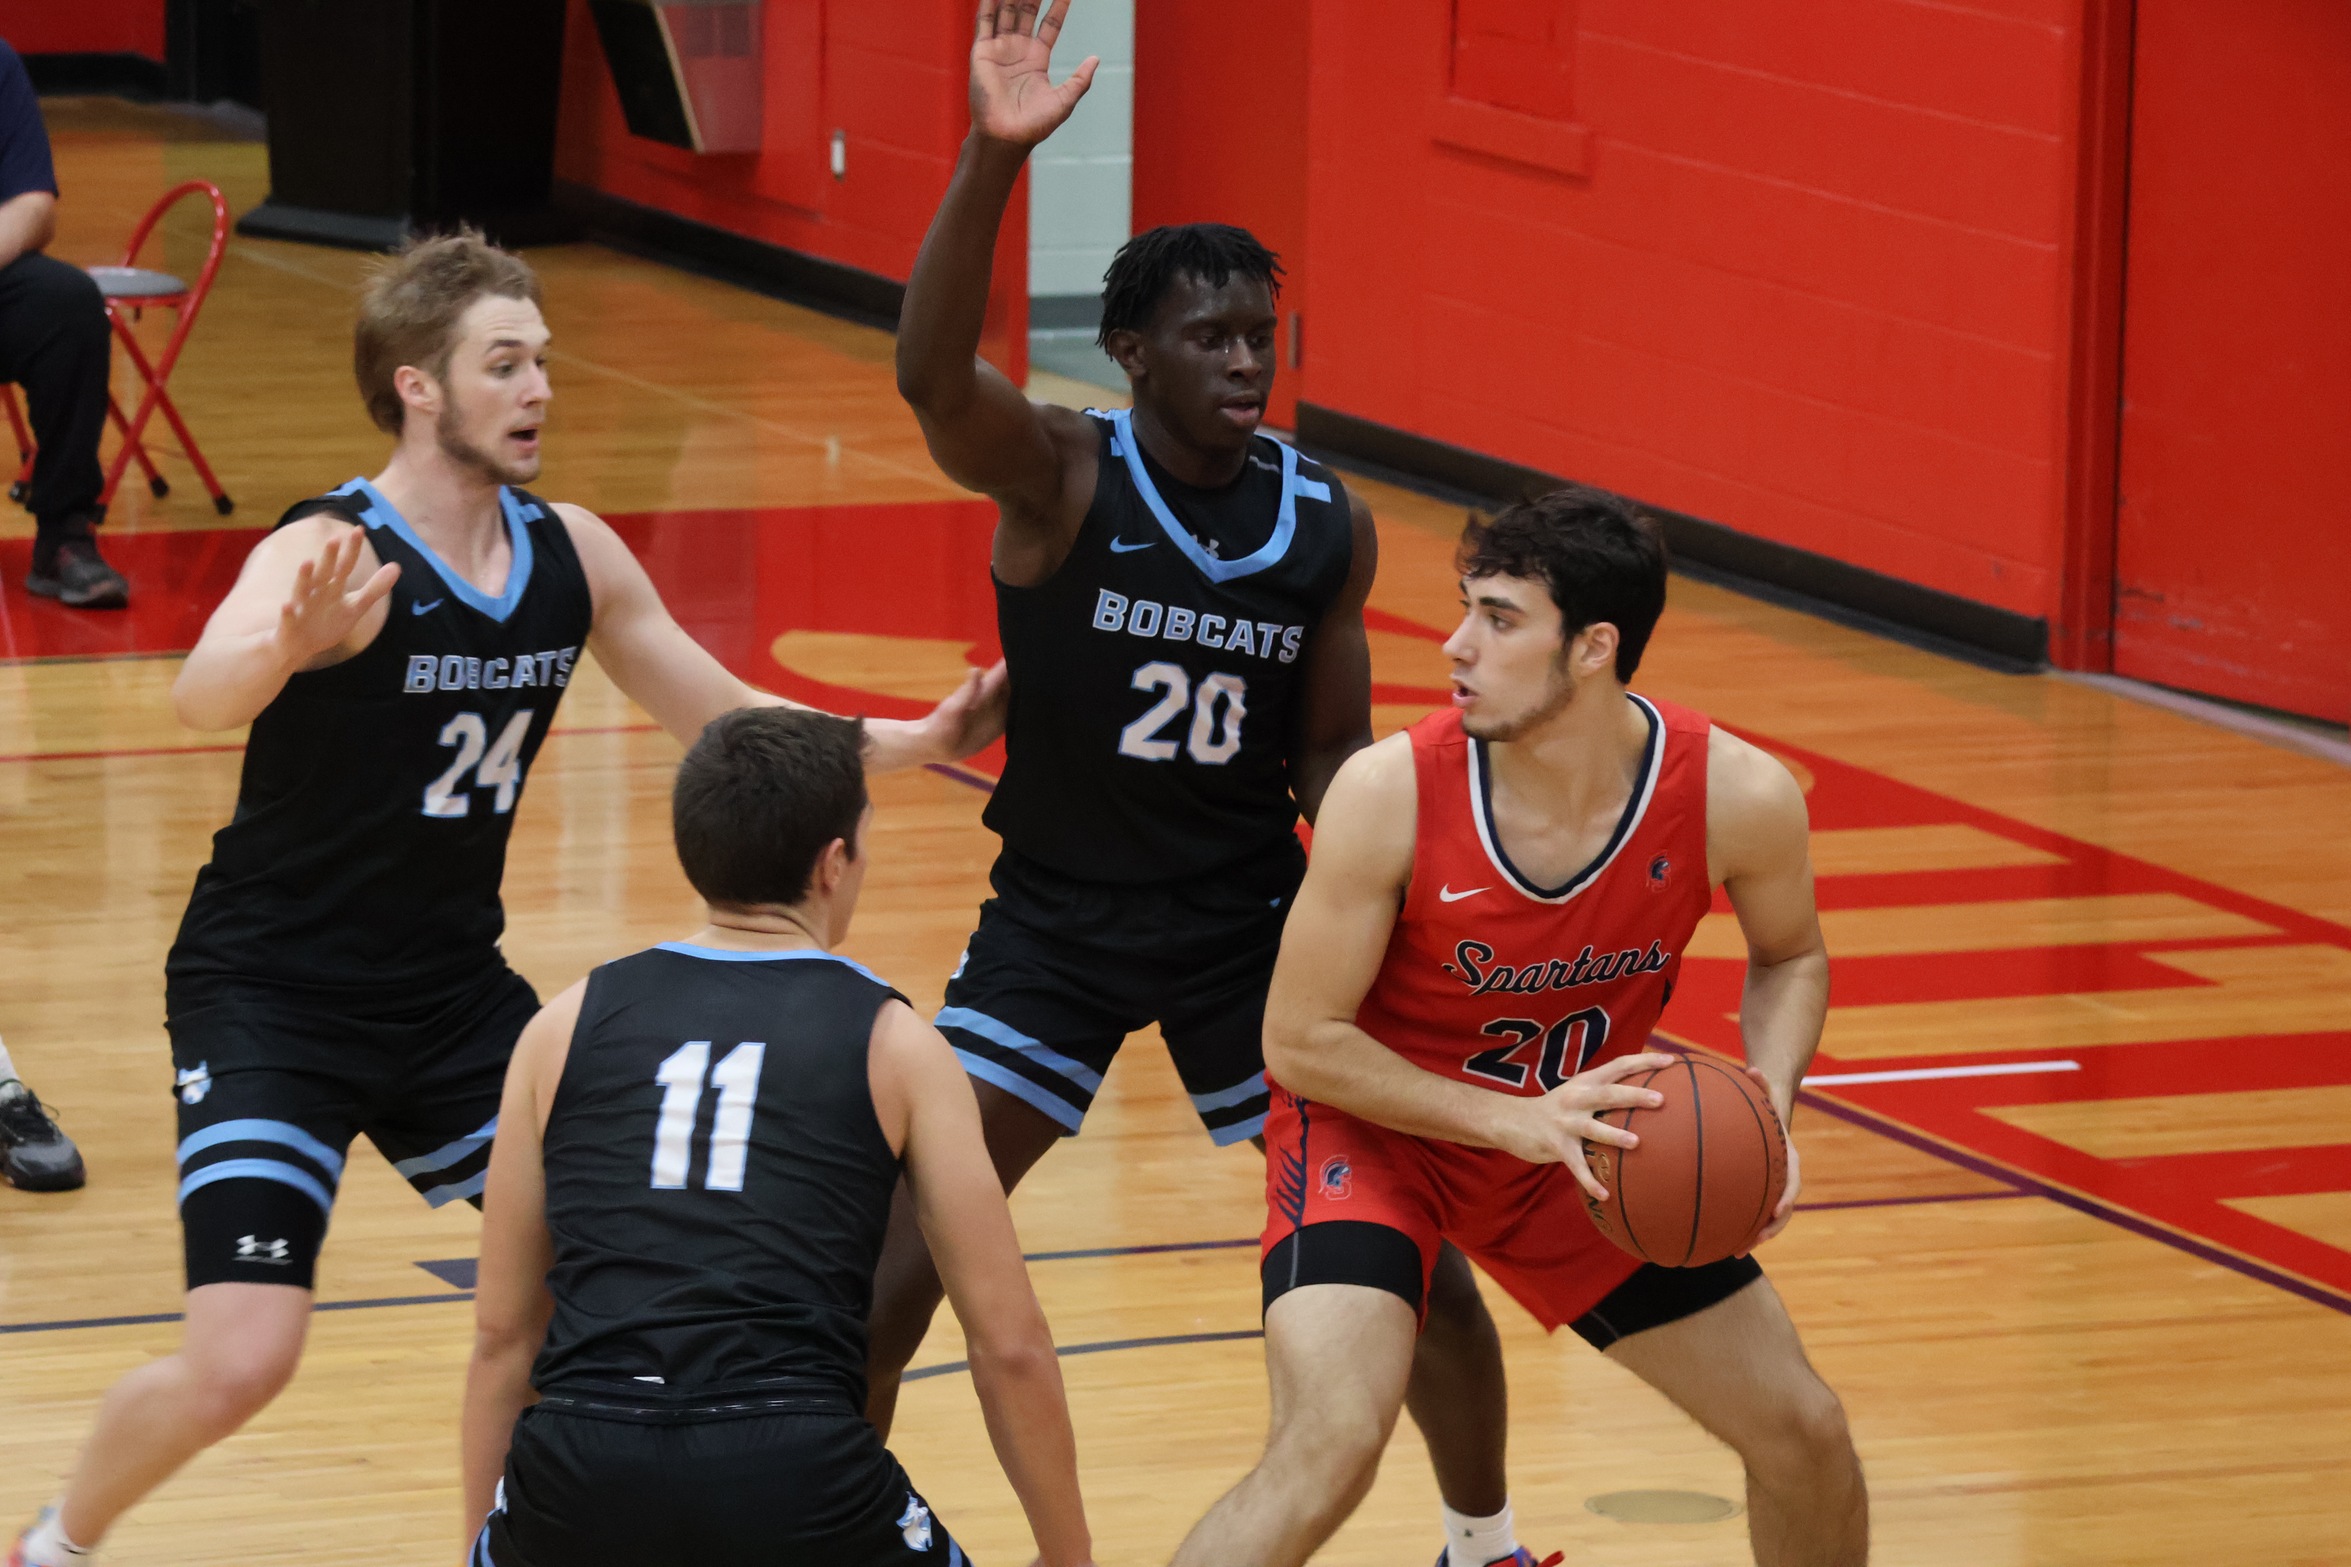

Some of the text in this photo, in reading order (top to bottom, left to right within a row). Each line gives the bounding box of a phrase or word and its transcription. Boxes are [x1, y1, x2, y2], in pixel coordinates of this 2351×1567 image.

[1093, 588, 1304, 663] BOBCATS
[1118, 661, 1248, 765] 20
[421, 708, 535, 818] 24
[1442, 939, 1671, 996] Spartans
[1462, 1005, 1610, 1094] 20
[650, 1041, 767, 1192] 11
